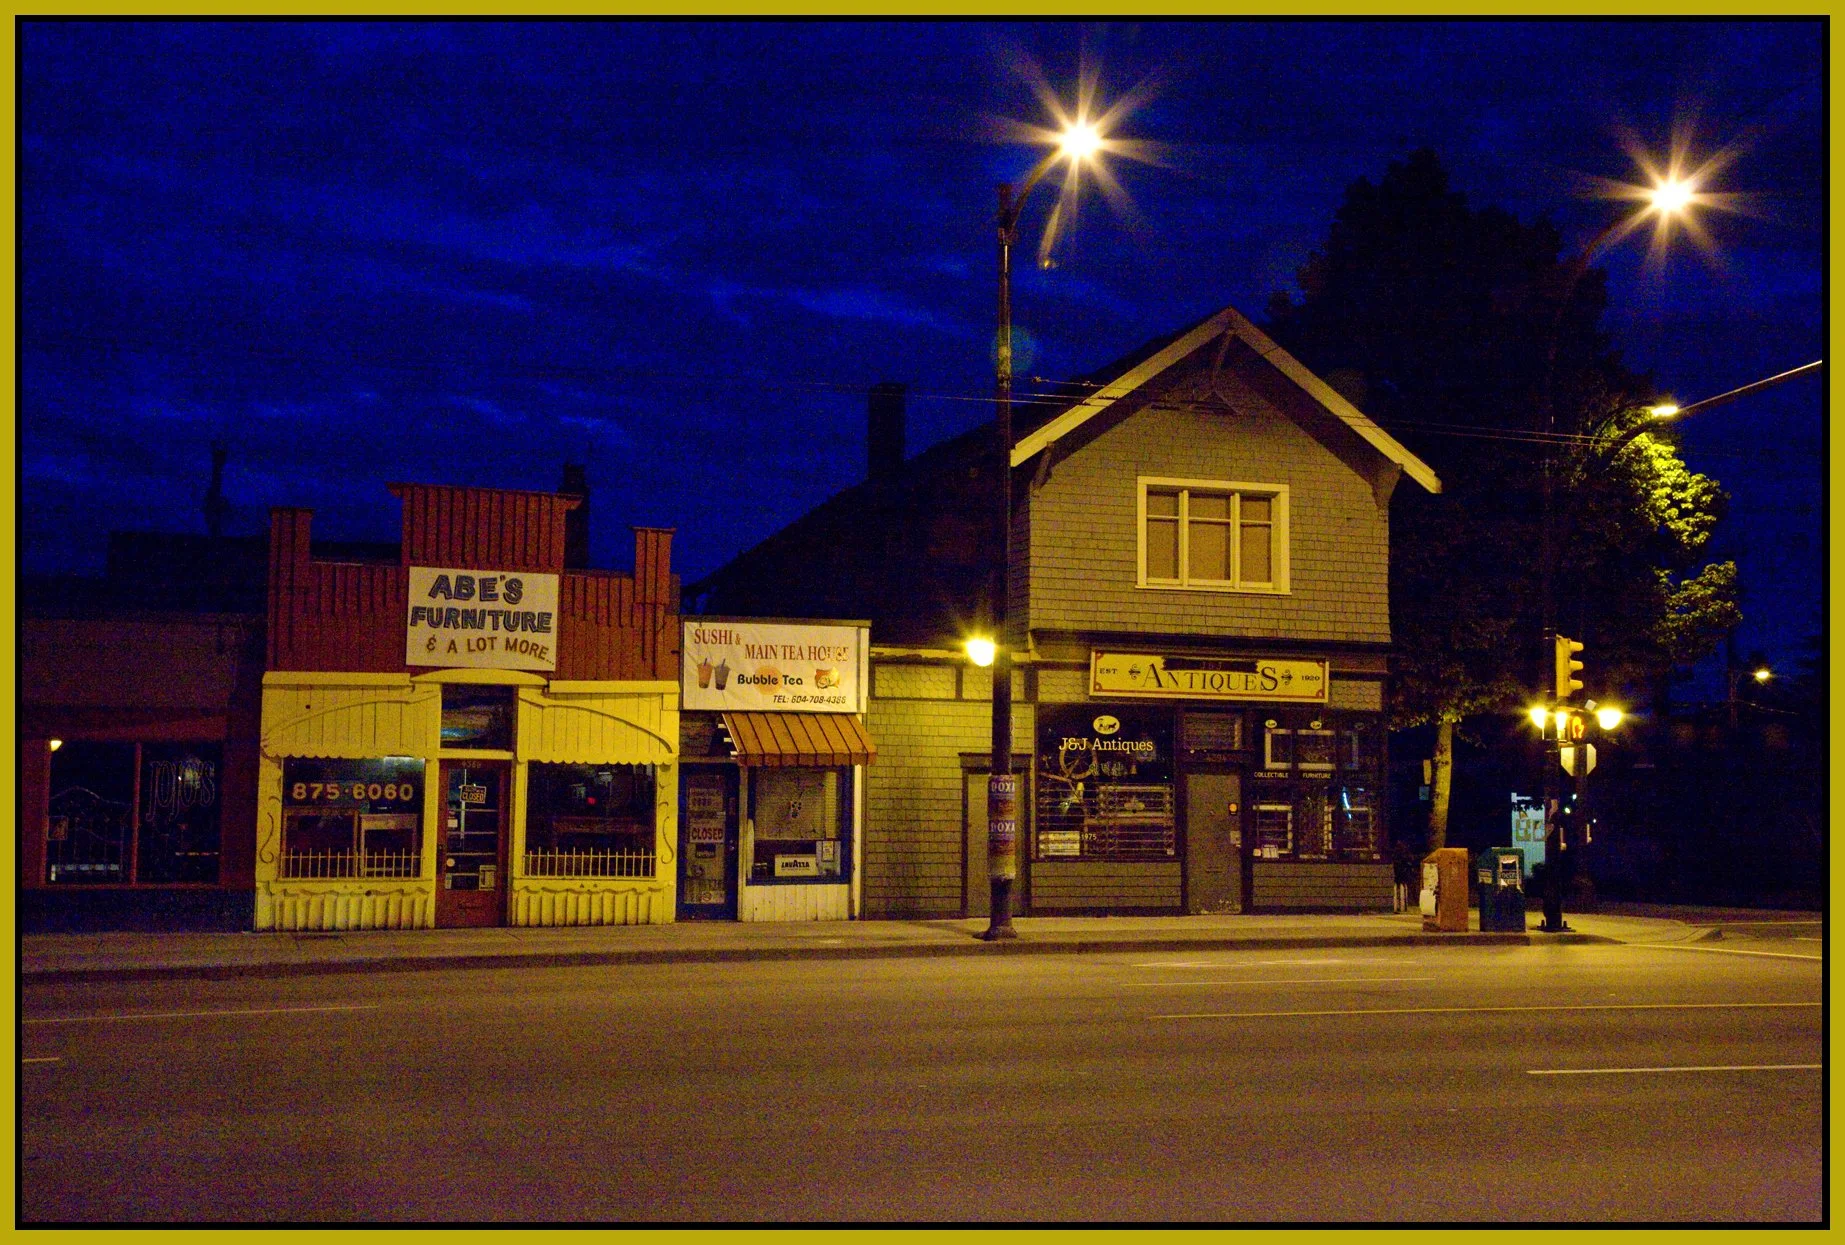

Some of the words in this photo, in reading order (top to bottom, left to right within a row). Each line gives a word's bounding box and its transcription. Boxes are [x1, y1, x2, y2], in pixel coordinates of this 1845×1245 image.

[428, 574, 523, 604] ABE'S
[410, 605, 552, 633] FURNITURE
[447, 639, 458, 653] A
[466, 636, 497, 652] LOT
[694, 628, 732, 645] SUSHI
[735, 633, 741, 645] &
[745, 644, 778, 660] MAIN
[781, 645, 804, 661] TEA
[737, 673, 778, 685] Bubble
[782, 674, 803, 685] Tea
[1143, 663, 1279, 692] ANTIQUES
[773, 695, 789, 704] TEL:
[1059, 737, 1089, 751] J&J
[1092, 737, 1154, 754] Antiques
[691, 827, 723, 840] CLOSED
